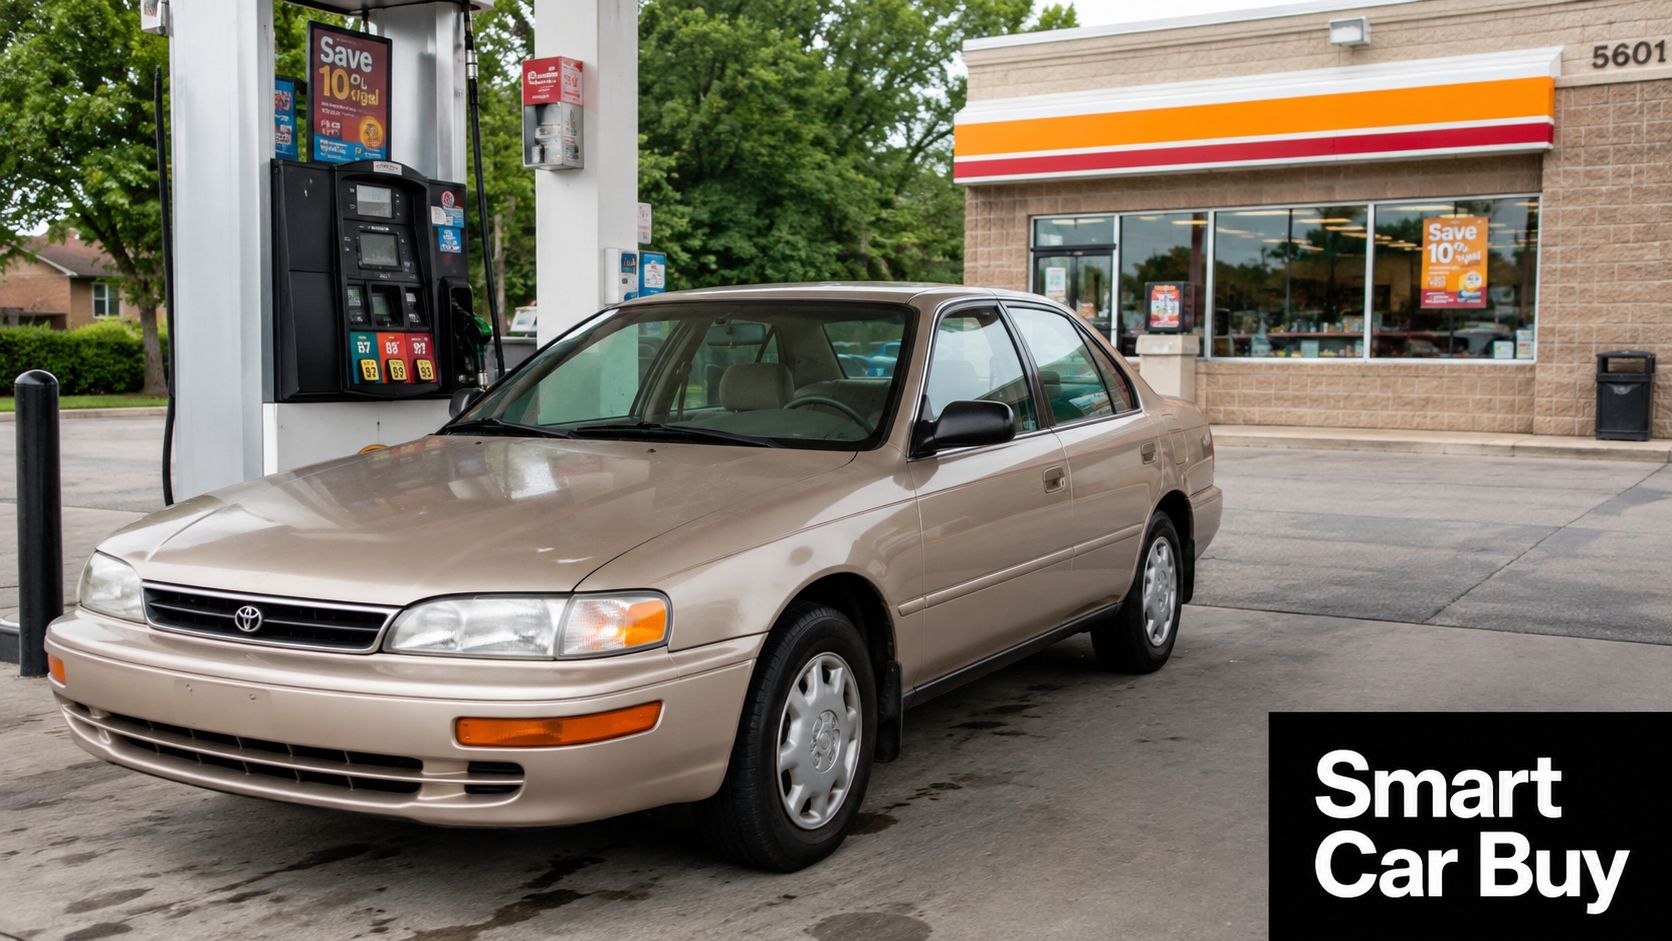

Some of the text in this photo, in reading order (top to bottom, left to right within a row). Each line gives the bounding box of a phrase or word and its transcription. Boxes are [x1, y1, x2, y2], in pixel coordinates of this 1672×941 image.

[320, 35, 372, 73] Save
[1592, 39, 1666, 69] 5601
[319, 65, 350, 100] 10
[1428, 222, 1478, 241] Save
[1427, 242, 1454, 264] 10
